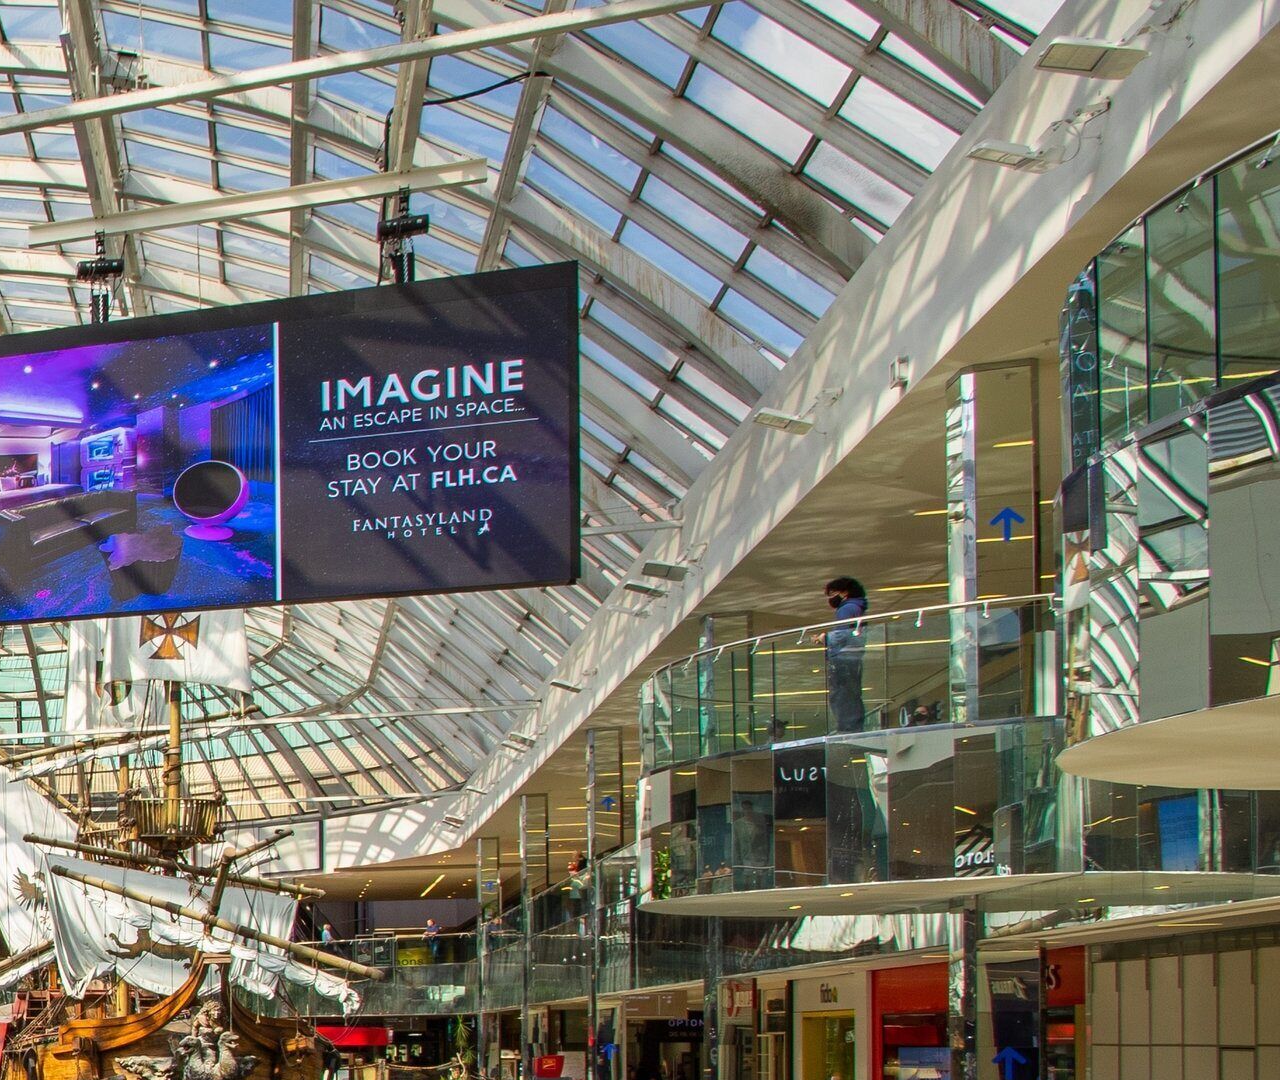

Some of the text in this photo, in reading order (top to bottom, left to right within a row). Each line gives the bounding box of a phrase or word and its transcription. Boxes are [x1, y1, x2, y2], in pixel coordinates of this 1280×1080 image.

[320, 358, 525, 412] IMAGINE
[319, 397, 527, 431] AN ESCAPE IN SPACE...
[346, 440, 497, 471] BOOK YOUR
[327, 464, 518, 498] STAY AT FLH.CA
[352, 508, 494, 532] FANTASYLAND
[387, 525, 458, 540] HOTEL
